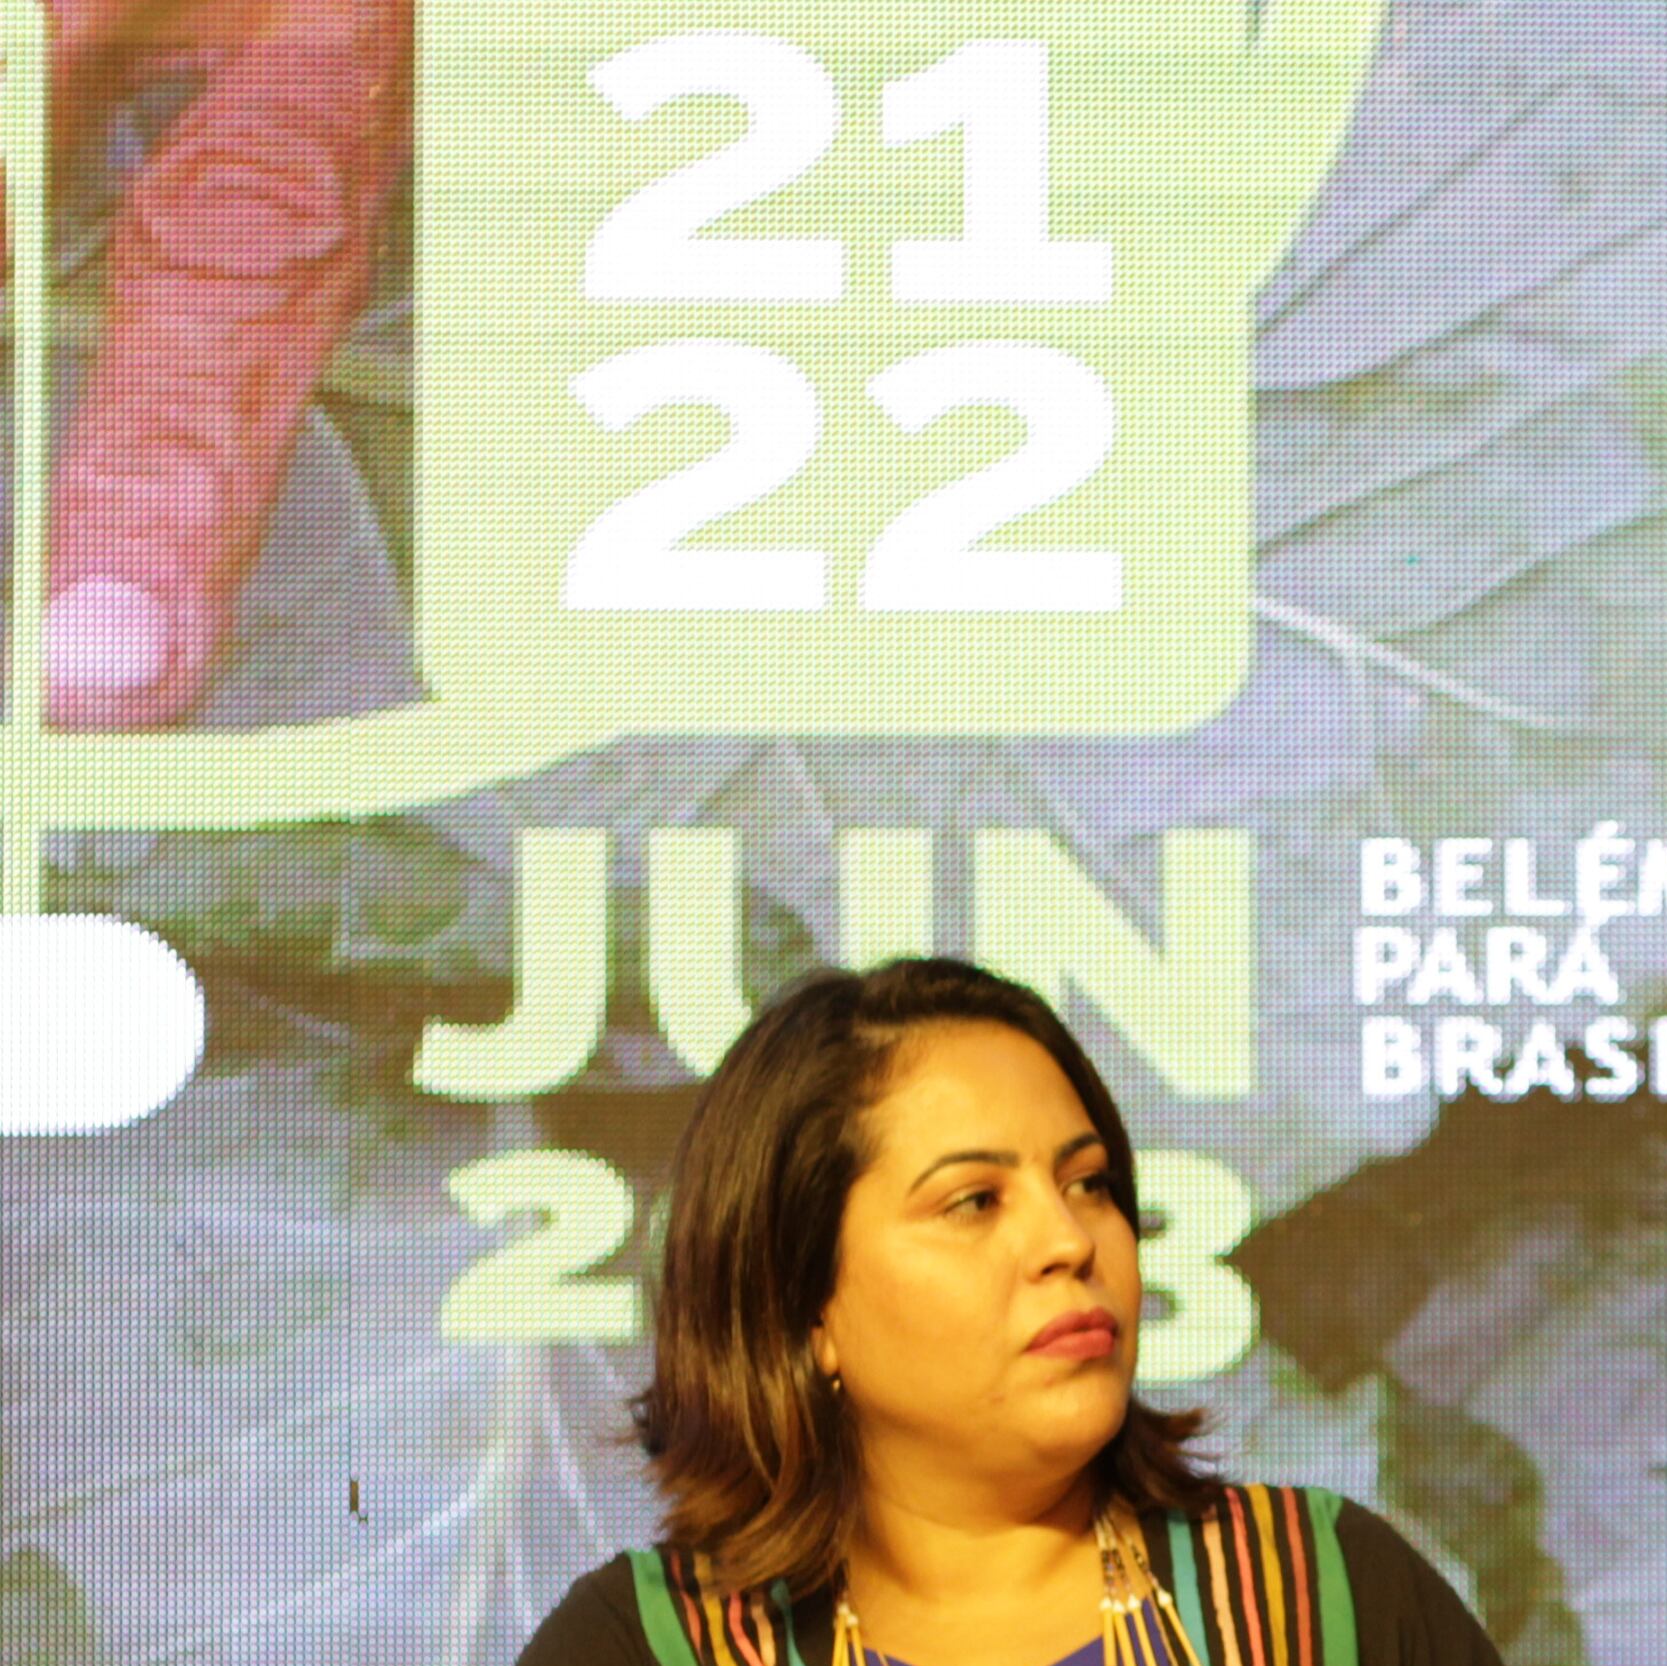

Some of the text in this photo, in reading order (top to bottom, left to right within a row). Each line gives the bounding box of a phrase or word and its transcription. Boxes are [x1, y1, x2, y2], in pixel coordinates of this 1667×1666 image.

[582, 28, 1114, 301] 21
[564, 337, 1121, 612] 22
[414, 826, 1254, 1097] JUN
[1354, 912, 1622, 1006] PARÁ
[441, 1149, 1260, 1386] 23
